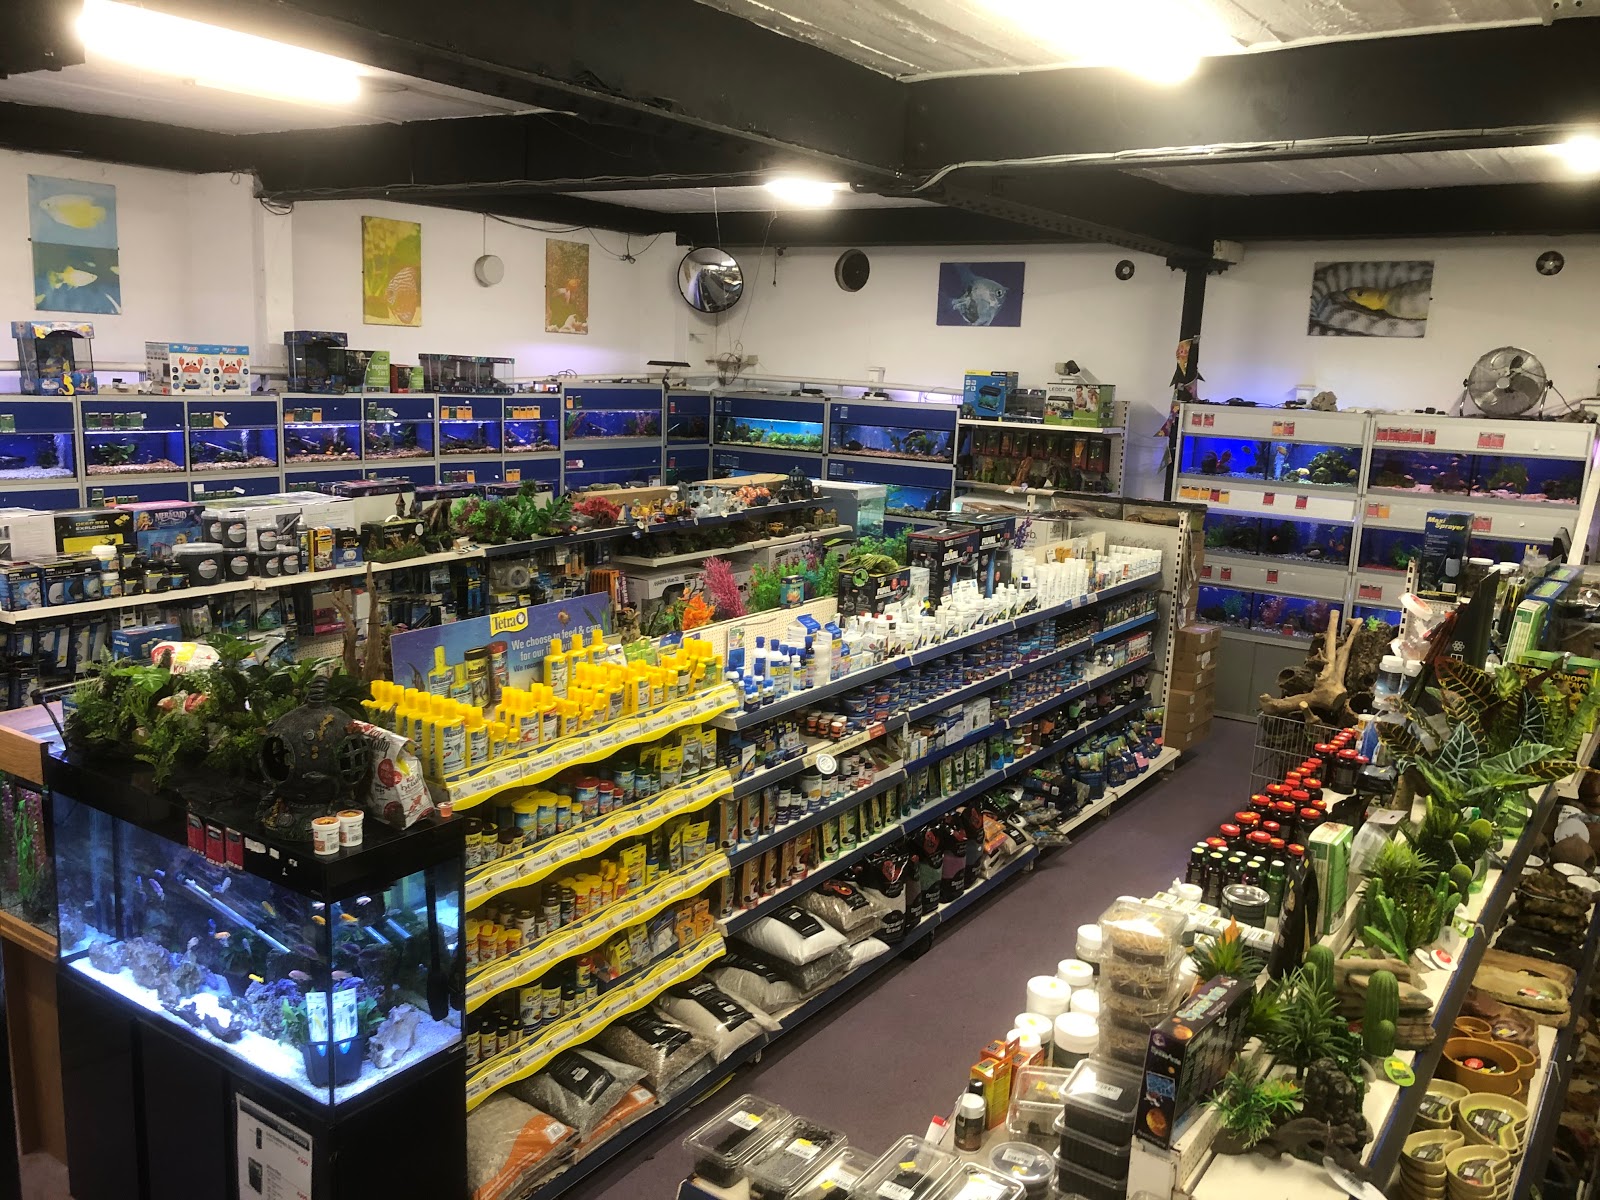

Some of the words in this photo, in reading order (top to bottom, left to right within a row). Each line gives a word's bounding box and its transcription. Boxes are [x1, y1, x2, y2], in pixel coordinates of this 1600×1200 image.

[1435, 522, 1465, 531] Sprayer
[492, 616, 516, 630] Tetra
[511, 640, 524, 650] We
[526, 636, 551, 647] choose
[562, 627, 577, 638] feed
[578, 625, 584, 635] &
[586, 624, 602, 633] care
[520, 651, 531, 661] for
[532, 649, 544, 658] our
[514, 664, 524, 672] We
